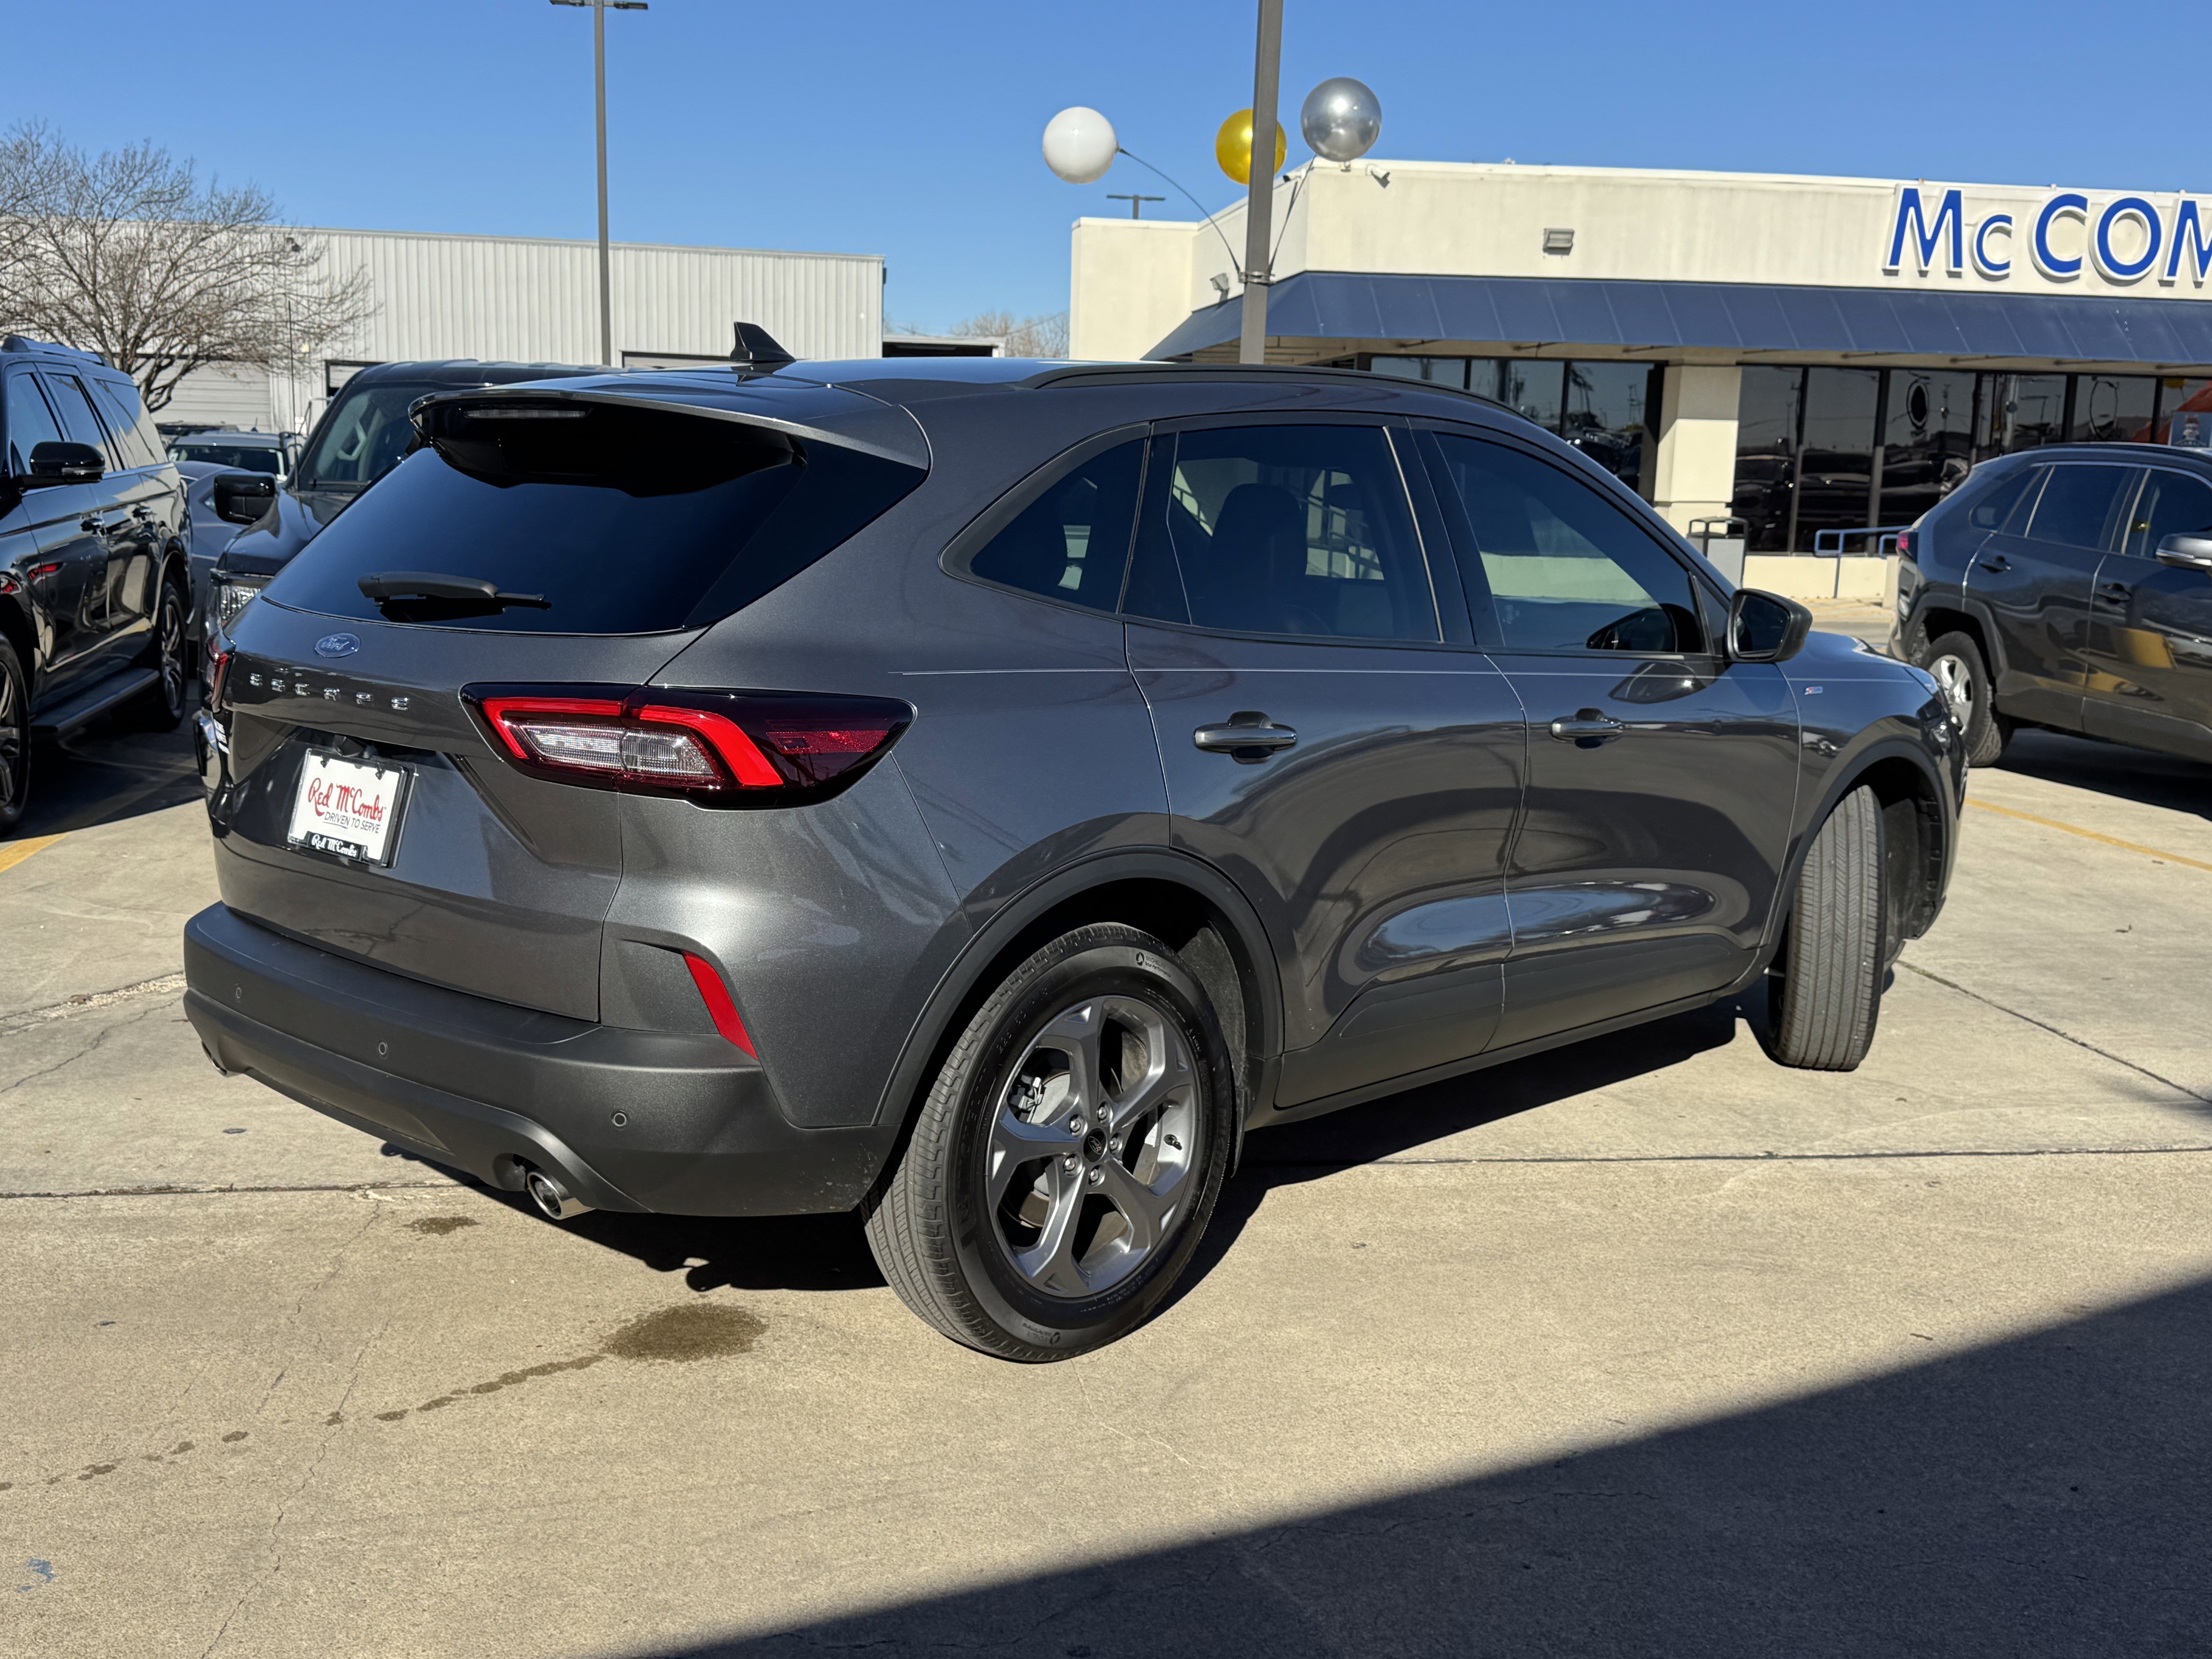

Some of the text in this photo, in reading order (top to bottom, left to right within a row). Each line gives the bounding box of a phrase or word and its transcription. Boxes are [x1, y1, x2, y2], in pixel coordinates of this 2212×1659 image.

[308, 777, 383, 822] Red McCombs
[324, 811, 381, 834] DRIVEN TO SERVE
[311, 833, 327, 849] Red
